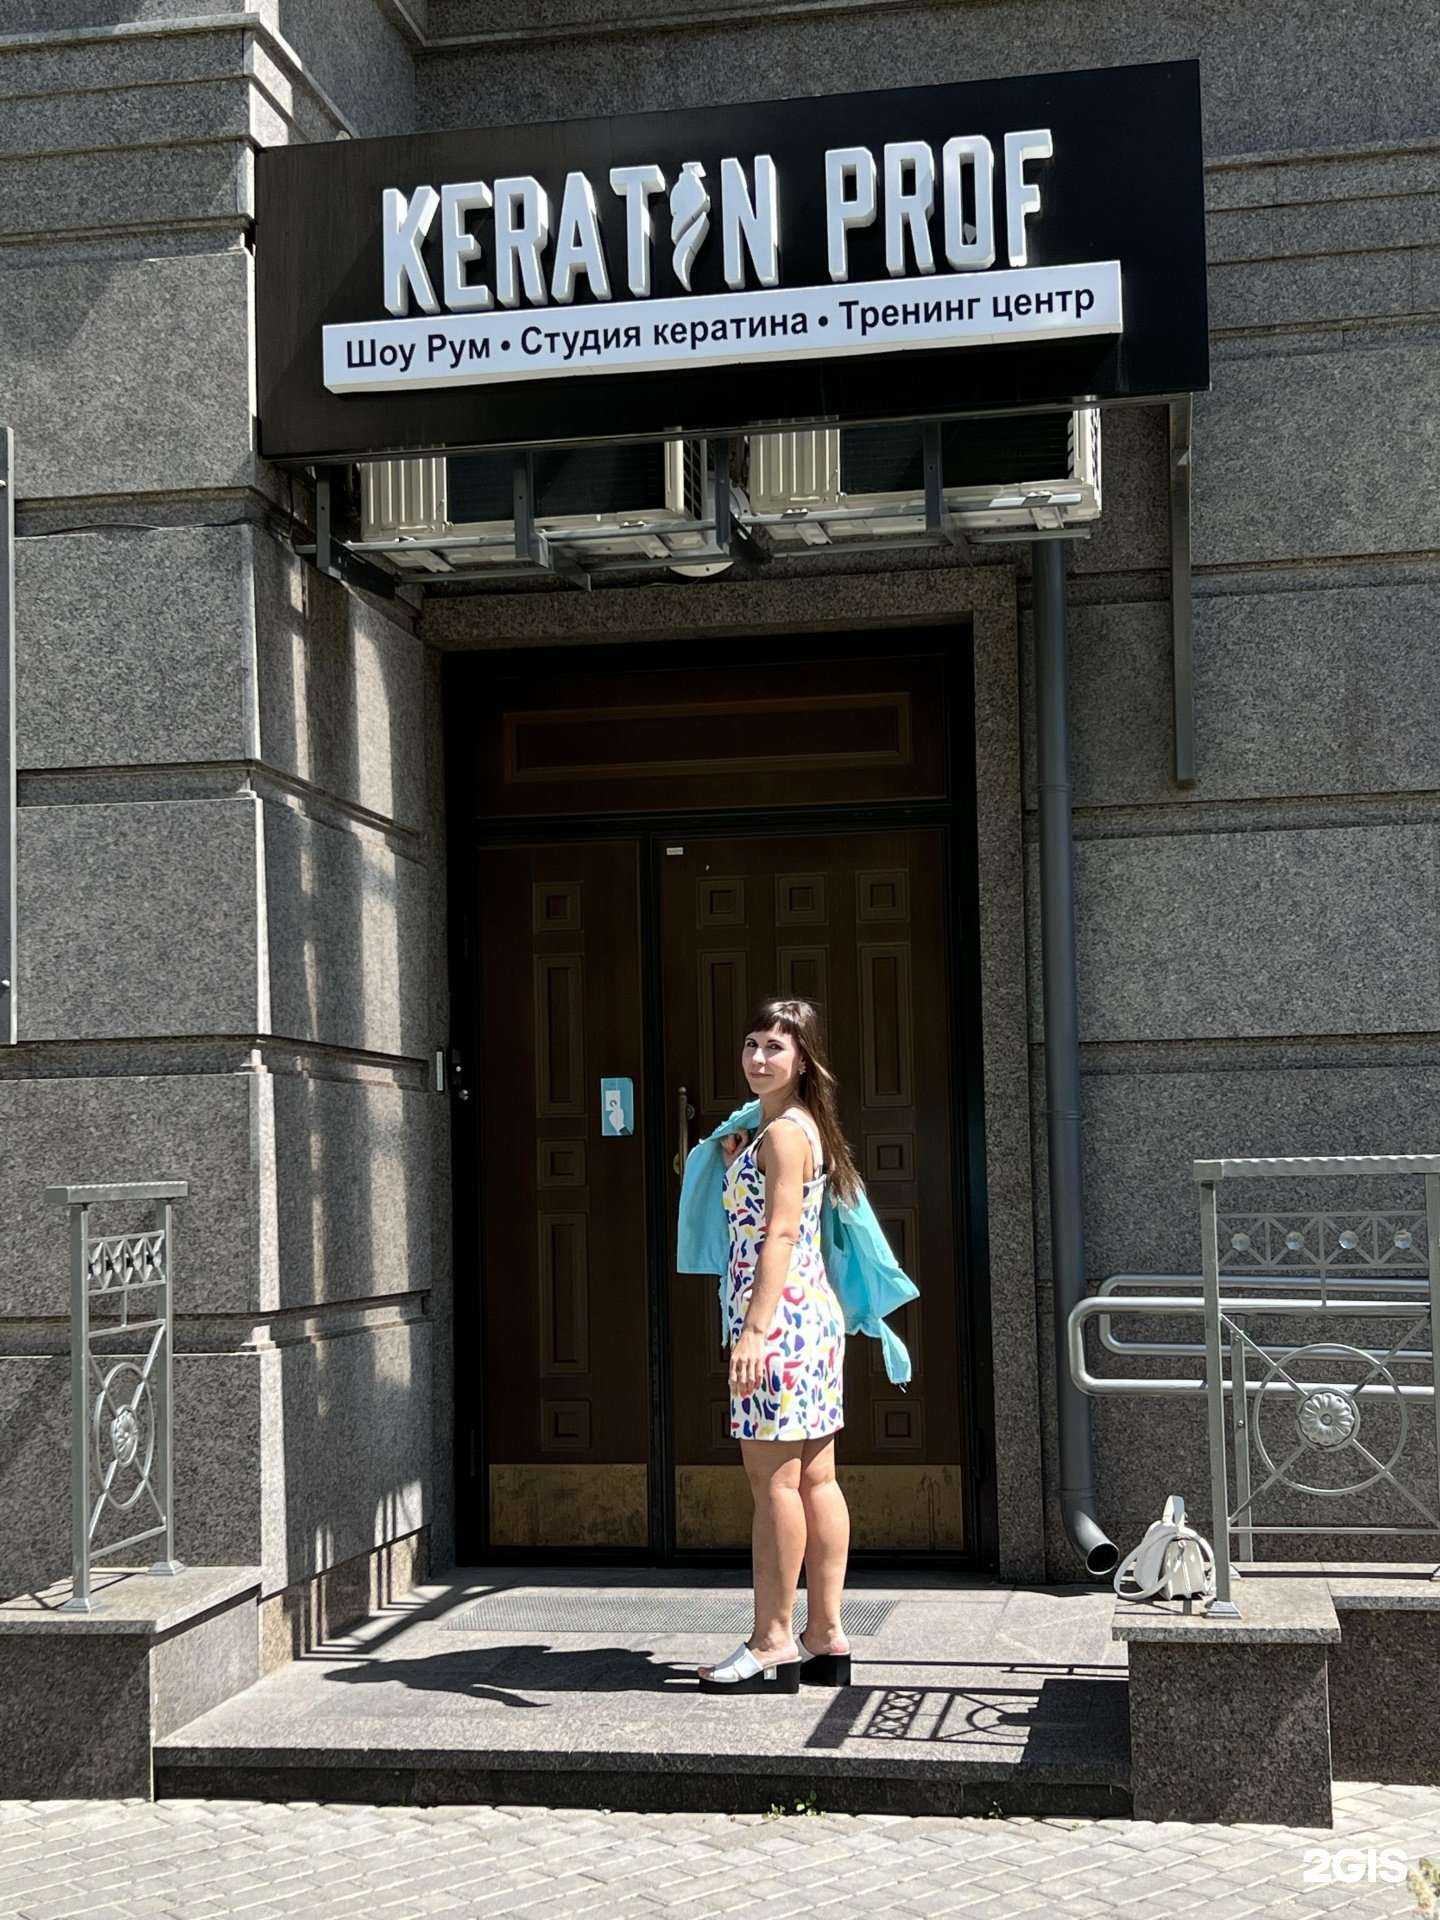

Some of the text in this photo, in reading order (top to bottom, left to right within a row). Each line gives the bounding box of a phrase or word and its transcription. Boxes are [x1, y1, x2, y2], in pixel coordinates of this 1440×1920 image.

[824, 128, 1053, 282] PROF
[346, 287, 1095, 372] Шоу Рум Студия кератина Тренинг центр
